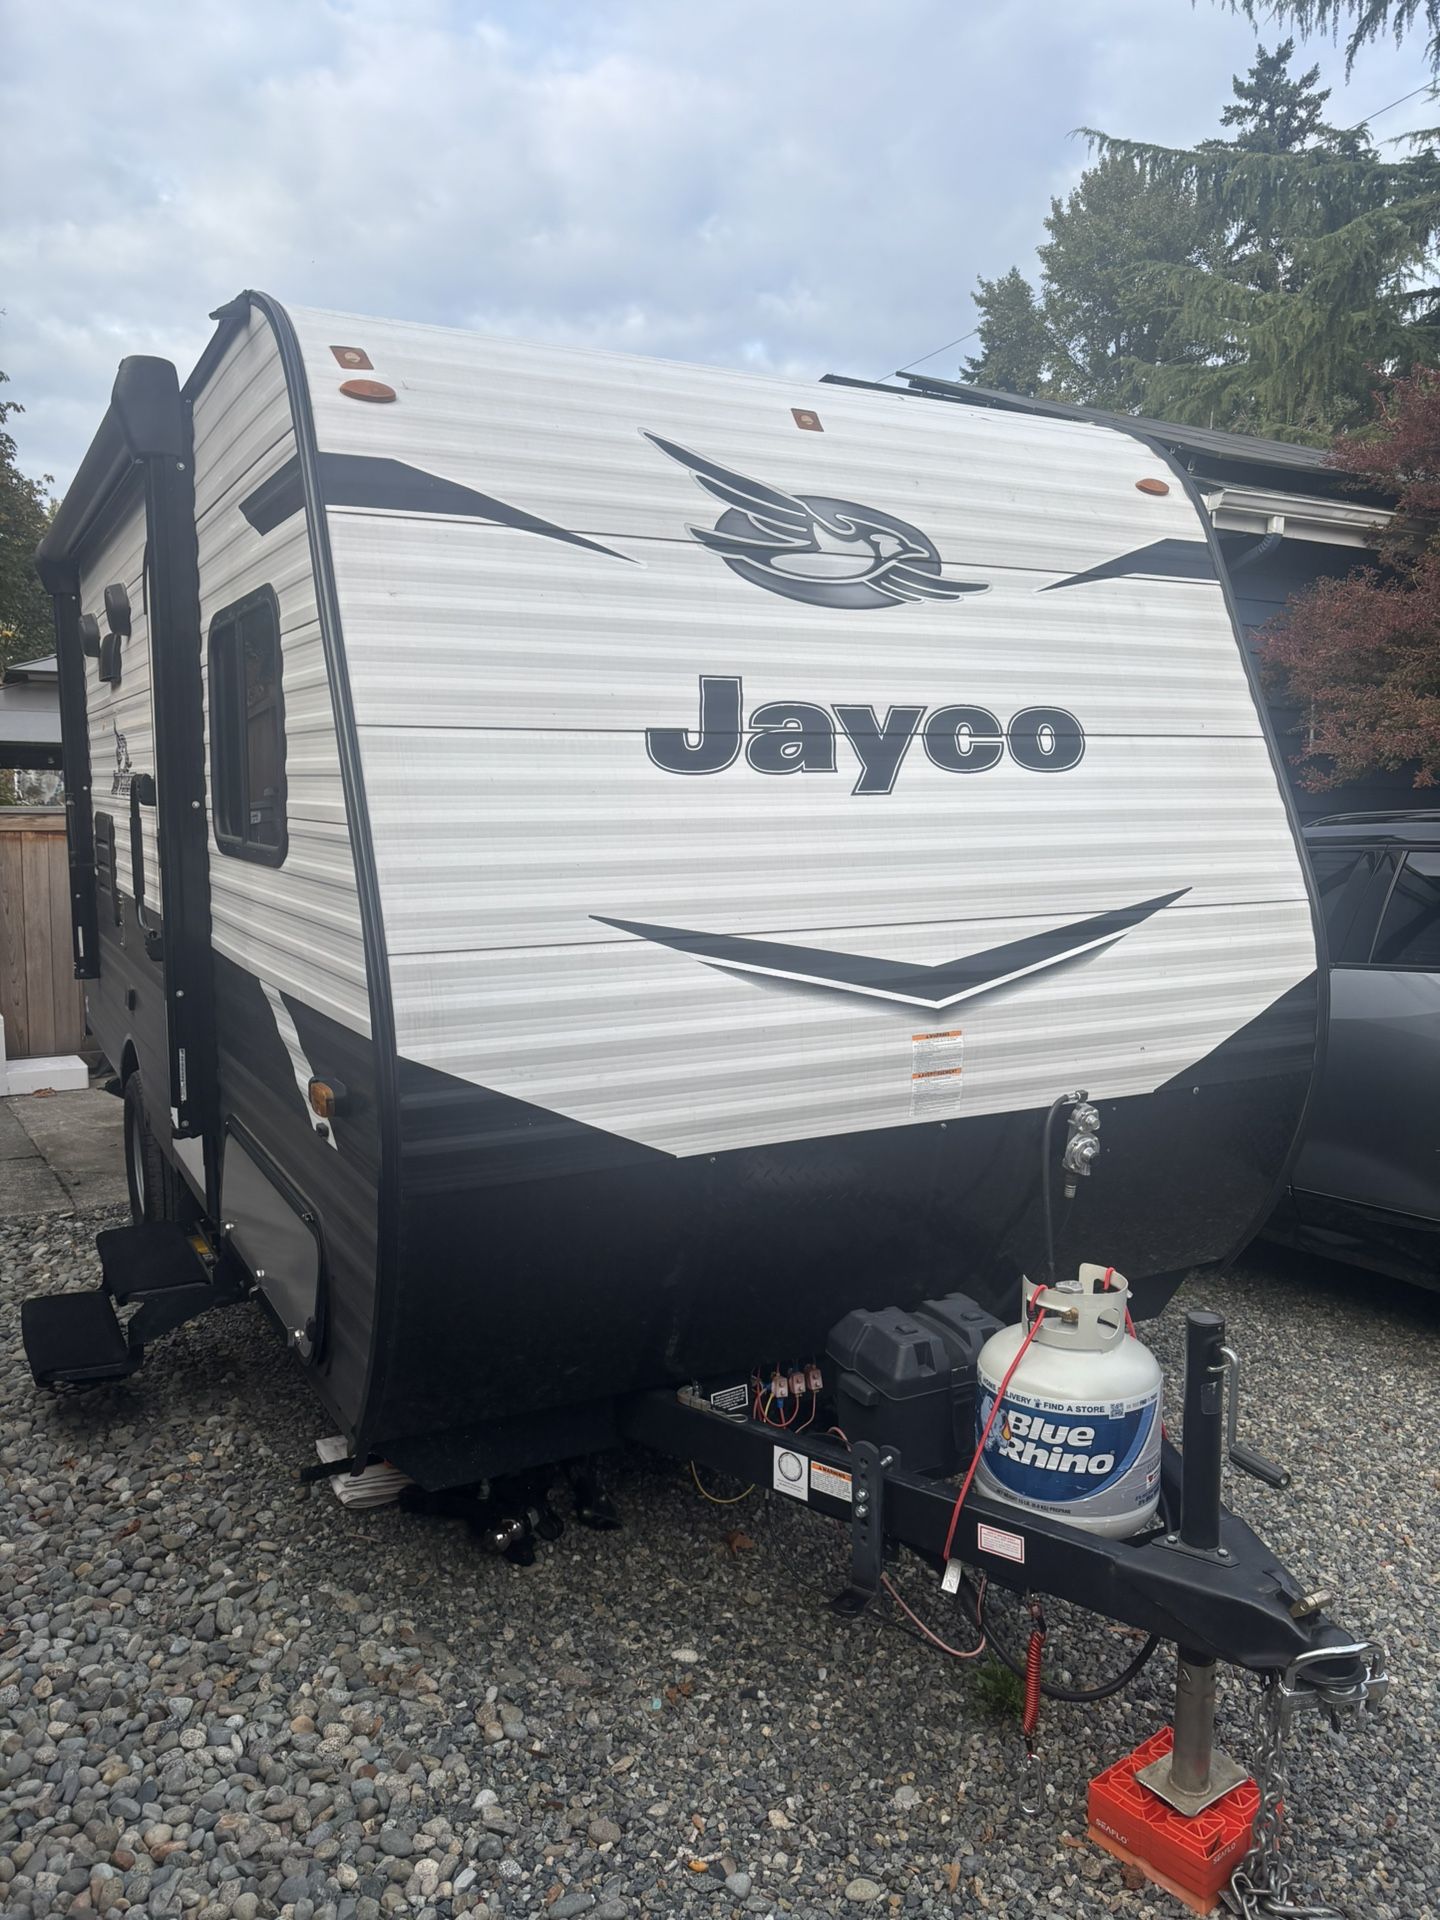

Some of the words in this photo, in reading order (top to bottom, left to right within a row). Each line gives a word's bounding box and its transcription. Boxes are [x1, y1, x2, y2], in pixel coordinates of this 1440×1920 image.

[646, 675, 1086, 796] Jayco
[1043, 1401, 1065, 1411] FIND
[1066, 1404, 1073, 1412] A
[1075, 1405, 1105, 1413] STORE
[1007, 1409, 1096, 1447] Blue
[998, 1436, 1115, 1475] Rhino
[1095, 1818, 1129, 1844] SEAFLO
[1212, 1842, 1236, 1864] SEAFLO
